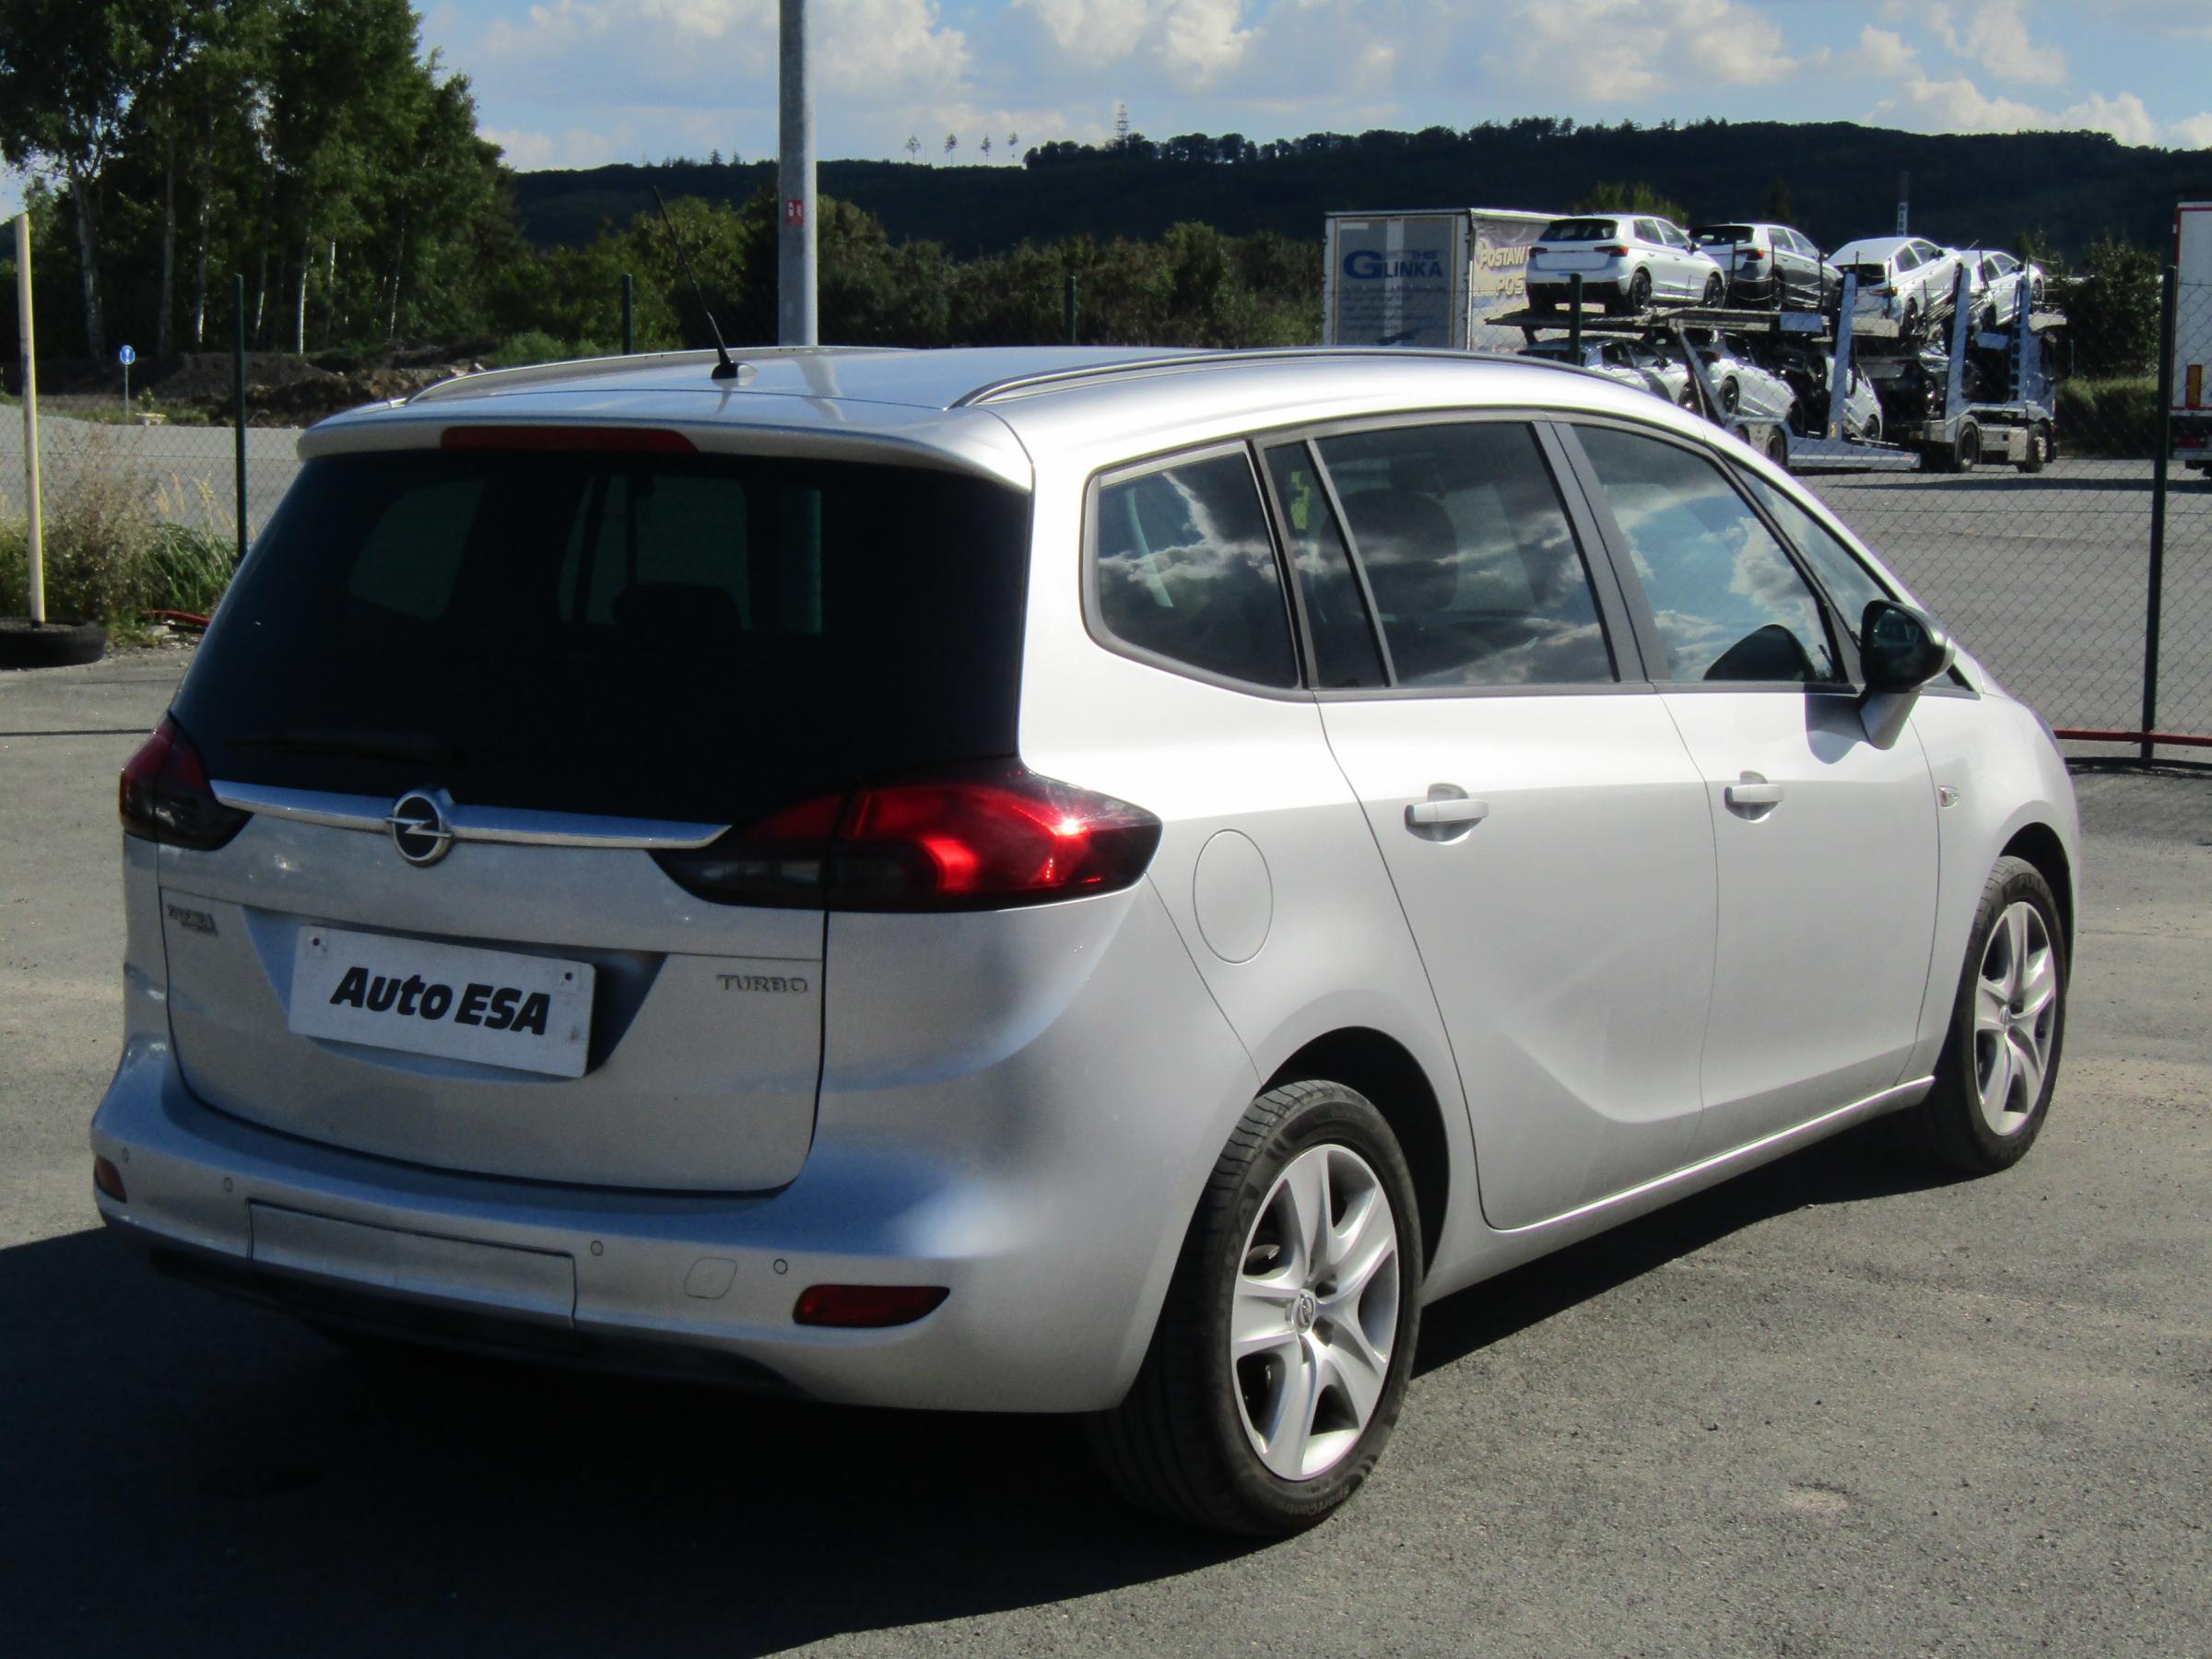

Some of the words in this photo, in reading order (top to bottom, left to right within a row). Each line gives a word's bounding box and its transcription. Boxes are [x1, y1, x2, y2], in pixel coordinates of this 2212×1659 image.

[1343, 249, 1442, 279] GLINKA
[715, 973, 809, 994] TURBO
[329, 966, 453, 1020] Auto
[453, 982, 551, 1036] ESA
